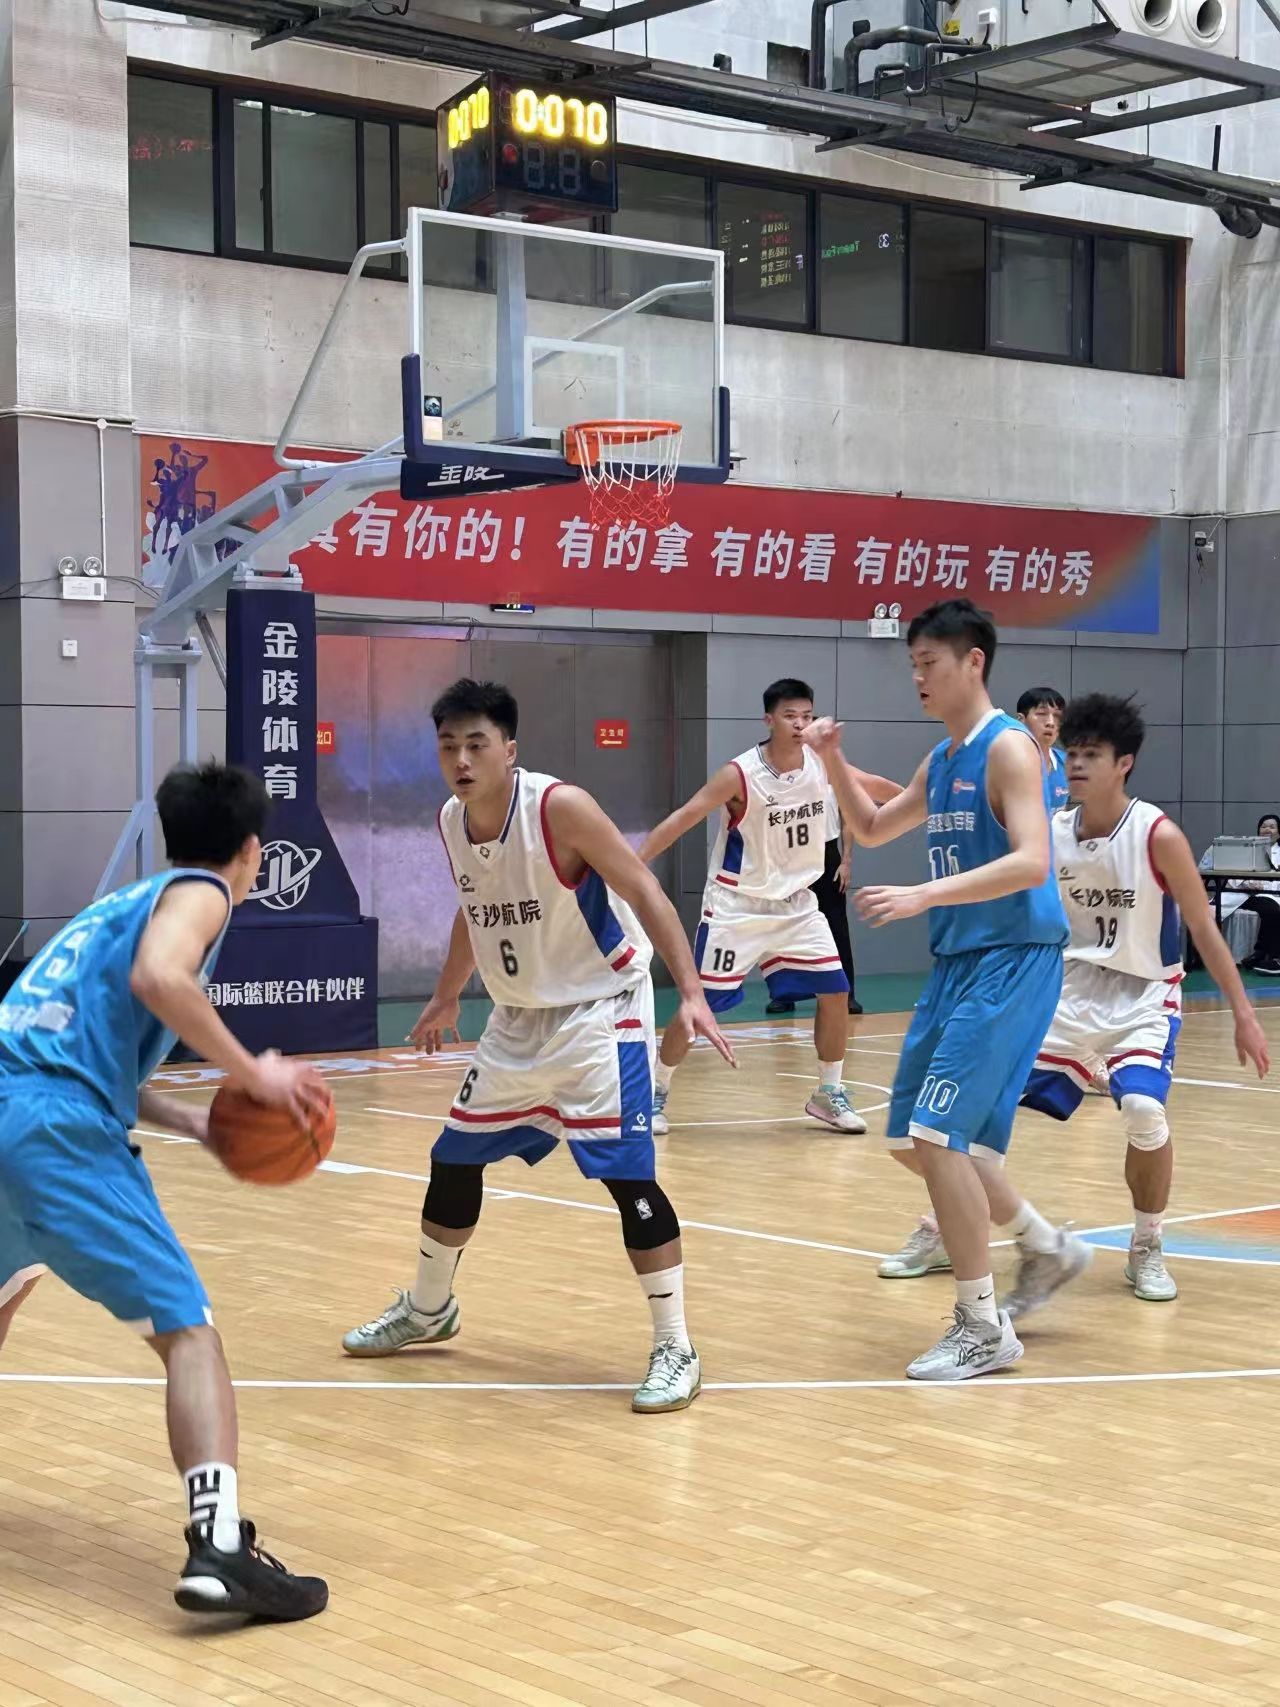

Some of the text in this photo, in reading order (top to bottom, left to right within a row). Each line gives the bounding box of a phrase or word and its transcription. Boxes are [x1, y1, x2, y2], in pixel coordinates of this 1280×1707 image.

[556, 515, 693, 574] 有的拿
[710, 526, 836, 583] 有的看
[853, 536, 970, 590] 有的玩
[985, 545, 1094, 597] 有的秀
[262, 621, 299, 799] 金陵体育
[786, 823, 809, 849] 18
[1094, 914, 1119, 949] 19
[500, 938, 519, 977] 6
[713, 947, 736, 972] 18
[207, 976, 365, 1006] 国际篮联合作伙伴
[459, 1068, 479, 1104] 6
[915, 1075, 960, 1115] 10
